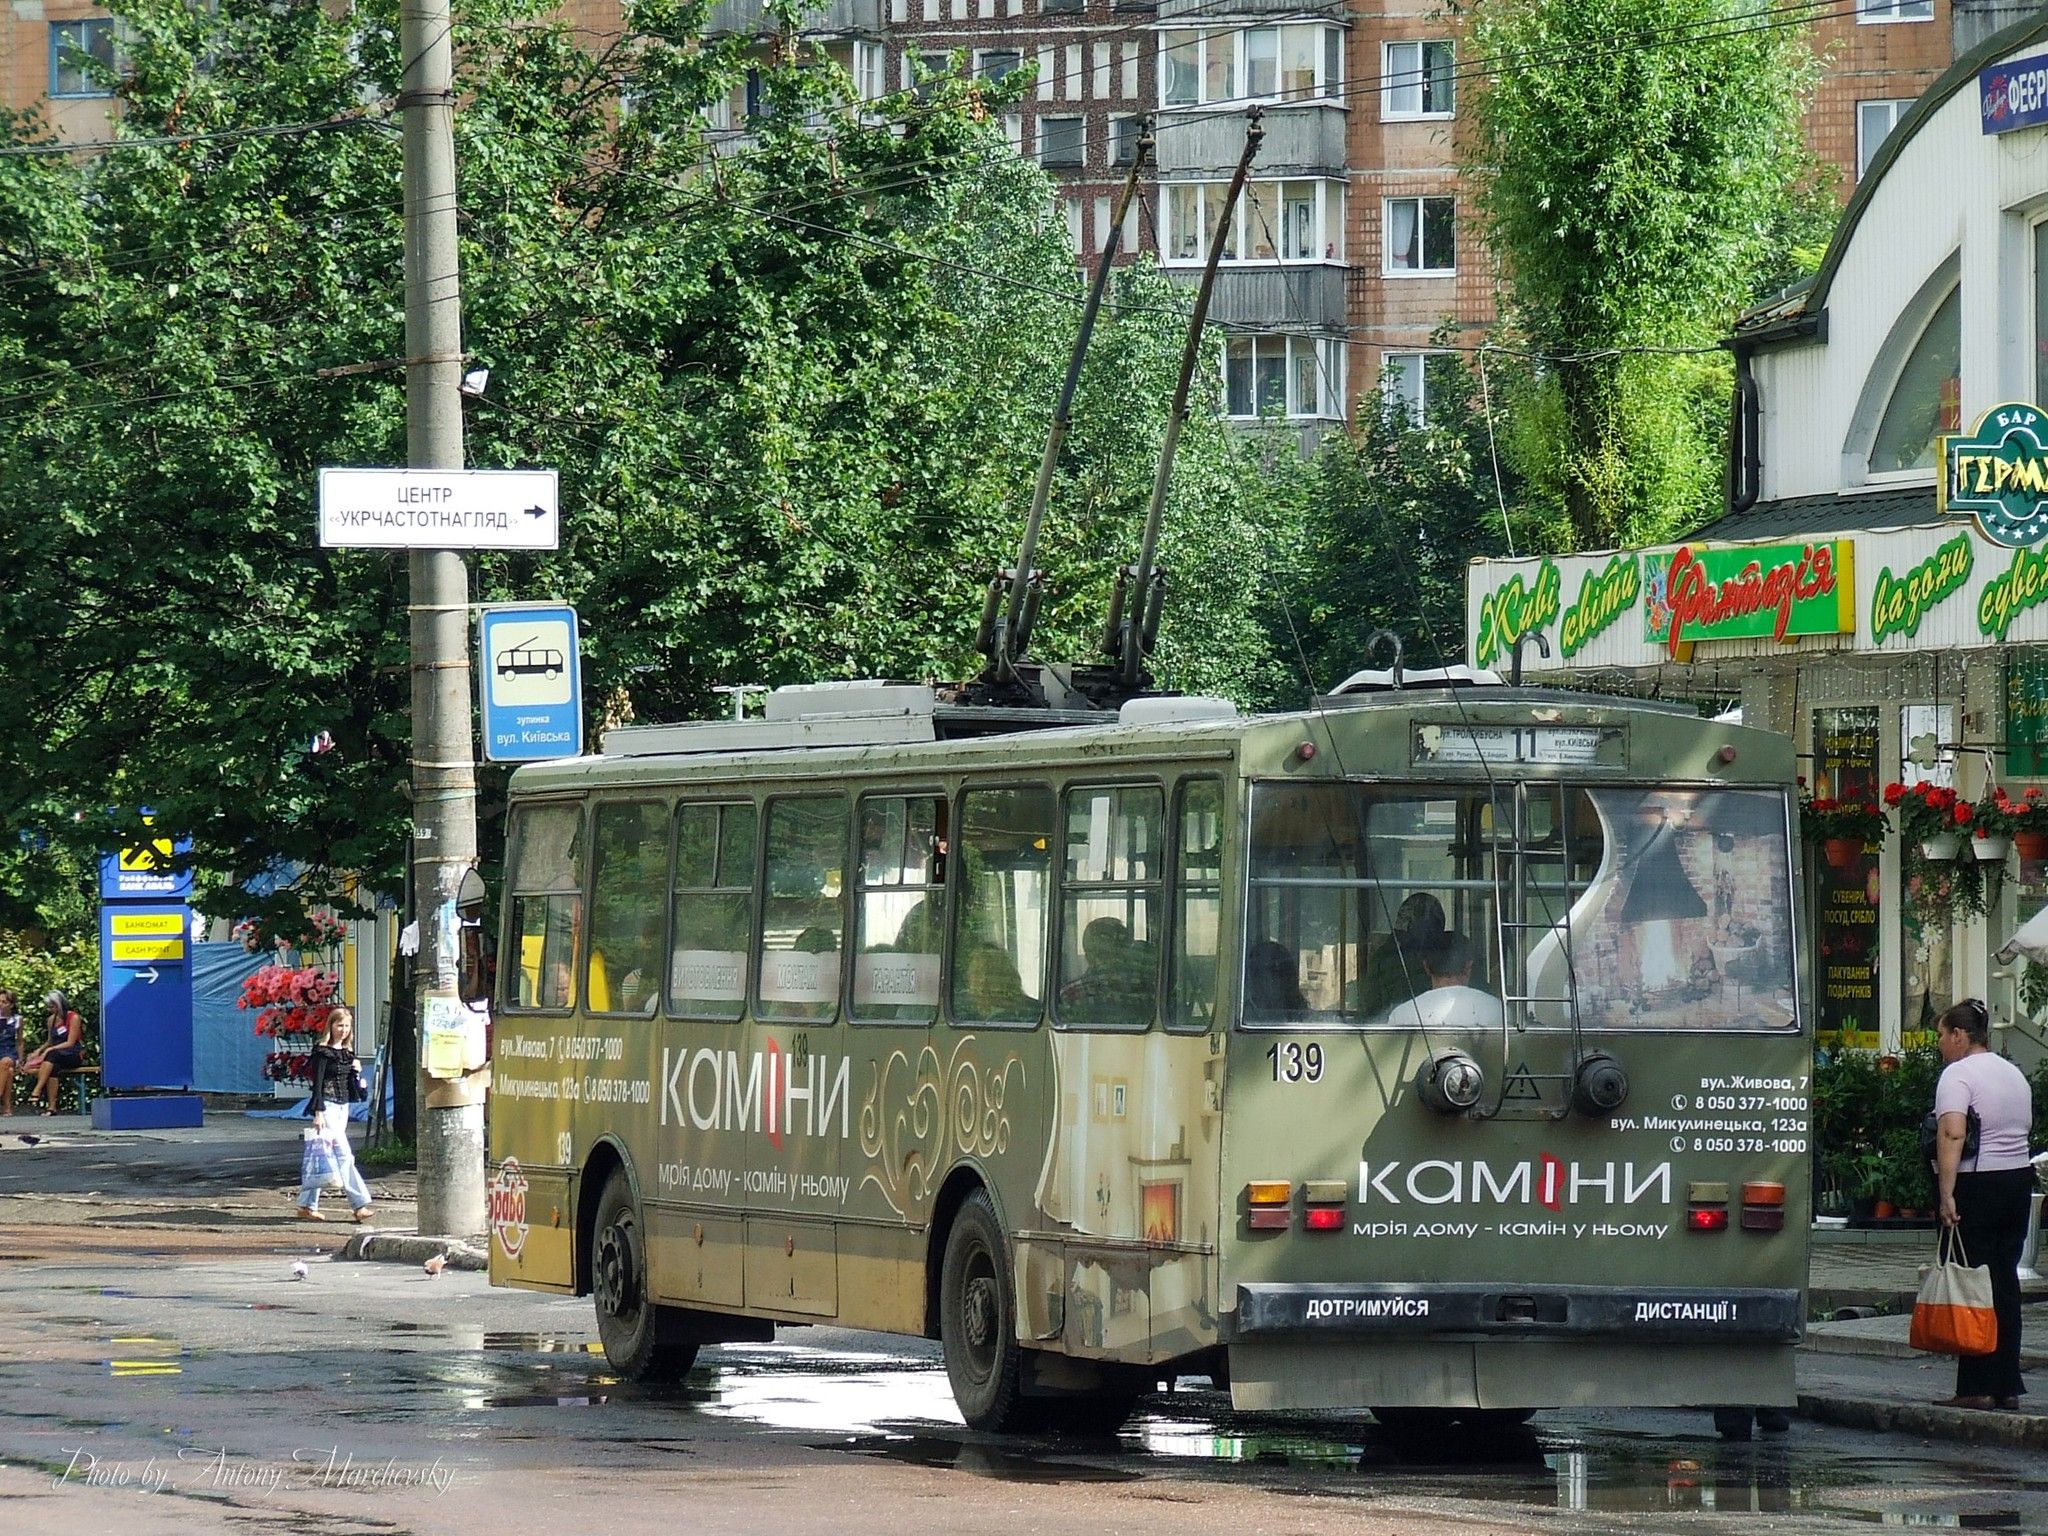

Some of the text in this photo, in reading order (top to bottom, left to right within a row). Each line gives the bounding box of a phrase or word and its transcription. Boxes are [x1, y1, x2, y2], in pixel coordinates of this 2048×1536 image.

[2007, 68, 2048, 115] ФЕЄР
[1996, 410, 2037, 427] БАР
[397, 487, 452, 506] ЦЕНТР
[1874, 539, 1969, 636] вазони
[1666, 544, 1837, 658] Фантазія
[1477, 558, 1638, 665] Живі квіти
[516, 715, 550, 727] зупинка
[497, 730, 571, 747] вул. Київська
[1510, 727, 1537, 758] 11
[125, 920, 168, 929] БАНКОМАТ
[125, 945, 170, 954] CASH POINT
[872, 963, 916, 994] ГАРАНТІЯ
[1827, 966, 1870, 980] ПАКУВАННЯ
[1827, 983, 1872, 1000] ПОДАРУНКІВ
[549, 1037, 555, 1059] 7
[791, 1033, 809, 1068] 139
[1266, 1042, 1325, 1084] 139
[1700, 1075, 1809, 1091] вул.Живова, 7
[1695, 1096, 1808, 1111] 8 050 377-1000
[1610, 1116, 1808, 1133] вул. Микулинецька, 123а
[1693, 1138, 1807, 1153] 8 050 378-1000
[658, 1159, 690, 1191] мрія
[692, 1167, 732, 1197] дому
[743, 1165, 787, 1194] камін
[789, 1174, 799, 1202] у
[801, 1174, 850, 1205] ньому
[1353, 1220, 1407, 1238] мрія
[1413, 1223, 1478, 1238] дому
[1499, 1220, 1566, 1236] камін
[1573, 1224, 1587, 1239] у
[1592, 1224, 1669, 1240] ньому
[1306, 1296, 1429, 1320] ДОТРИМУЙСЯ
[1635, 1300, 1729, 1323] ДИСТАНЦІЇ
